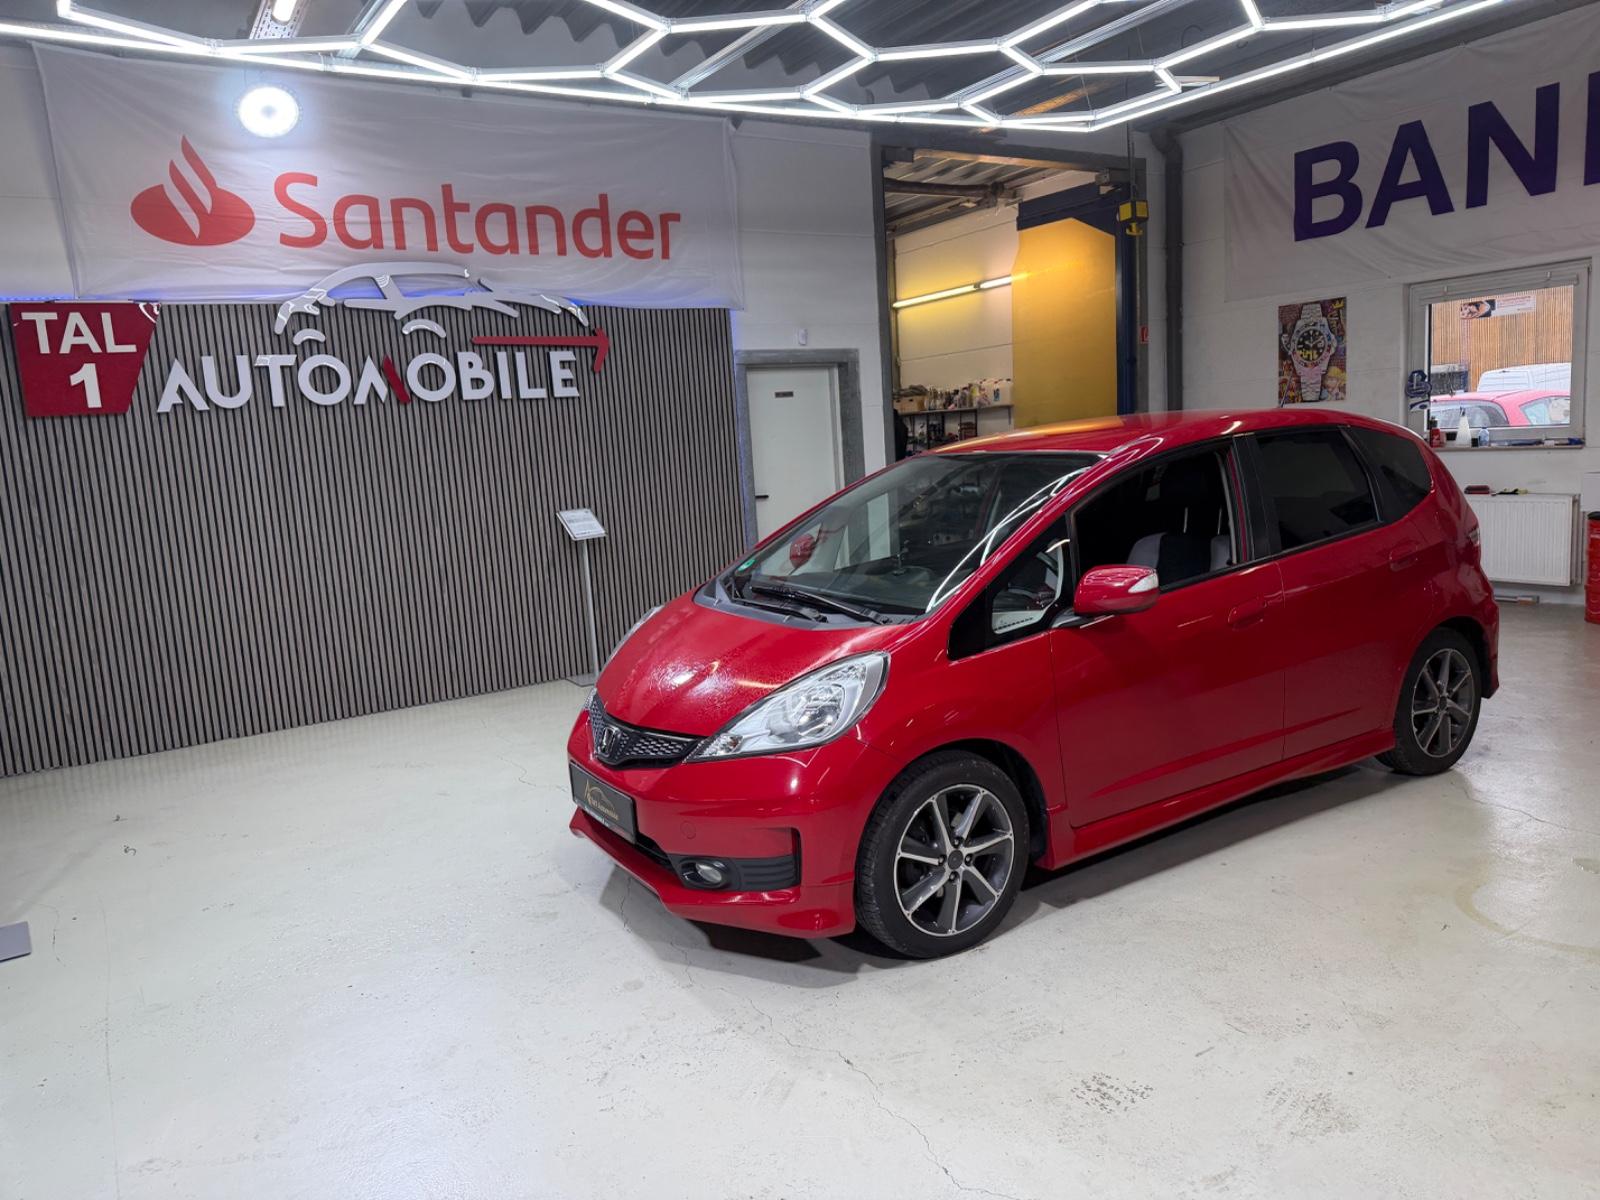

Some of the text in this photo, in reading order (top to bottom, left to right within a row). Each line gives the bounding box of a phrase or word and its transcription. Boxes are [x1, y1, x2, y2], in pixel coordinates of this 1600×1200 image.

[1294, 71, 1600, 241] BAN
[274, 172, 681, 260] Santander
[21, 312, 137, 354] TAL
[69, 363, 102, 409] 1
[156, 350, 580, 413] AUTOMOBILE
